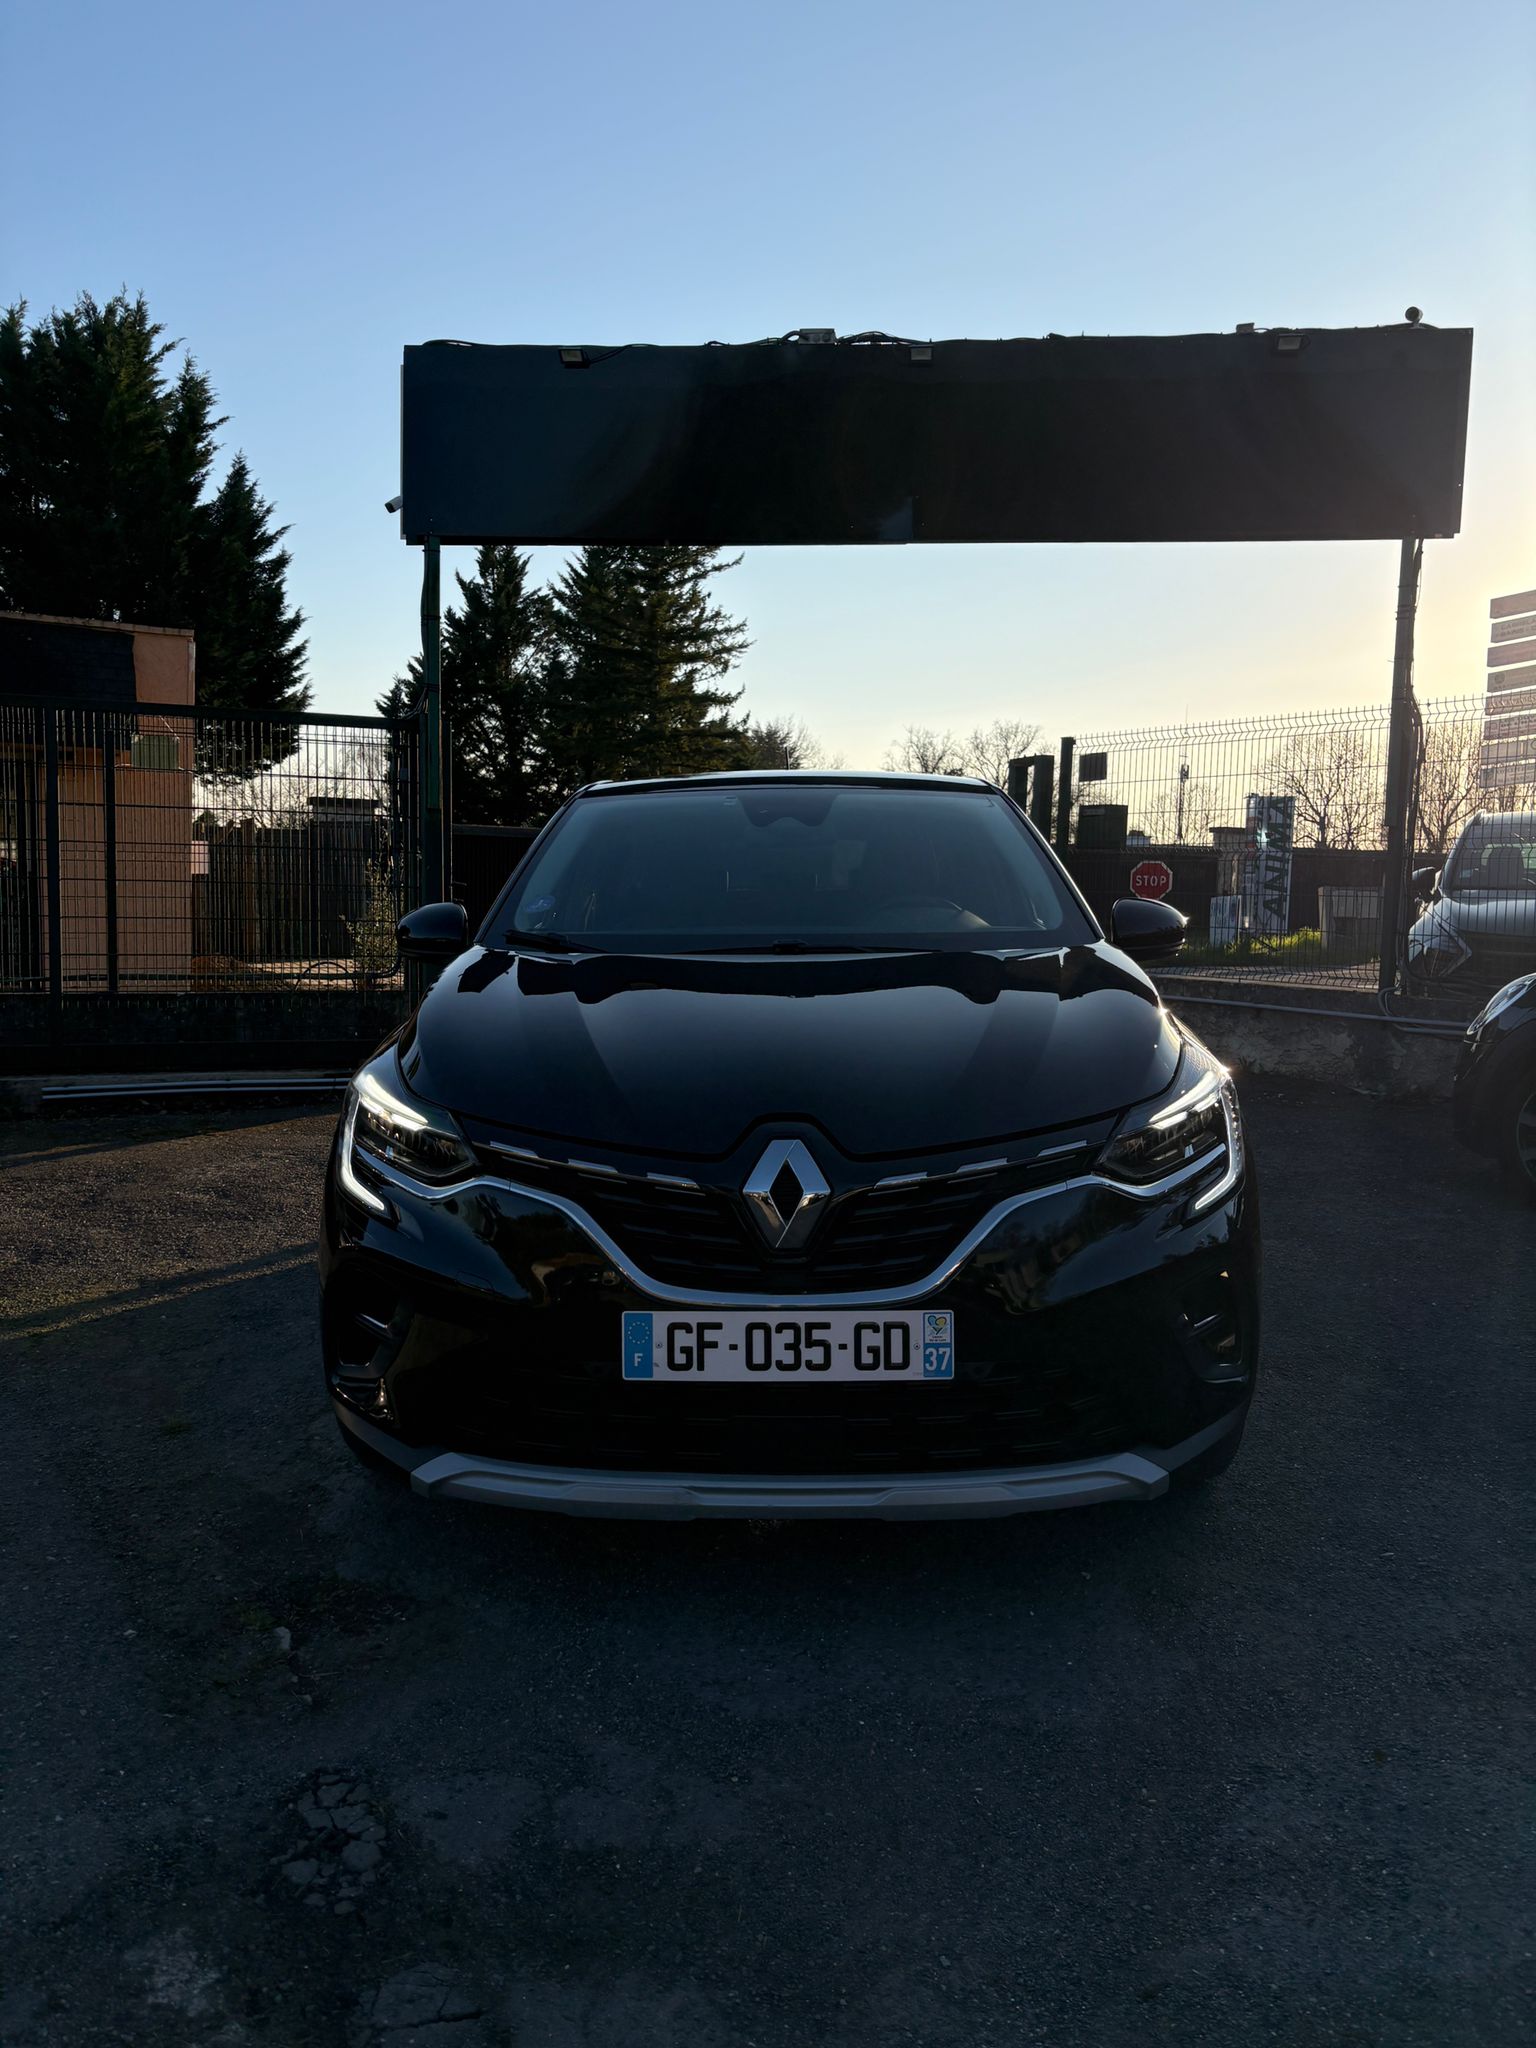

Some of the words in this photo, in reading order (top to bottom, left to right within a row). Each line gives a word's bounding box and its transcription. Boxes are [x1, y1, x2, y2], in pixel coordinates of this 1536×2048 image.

[1136, 875, 1167, 887] STOP
[667, 1321, 910, 1372] GF-035-GD
[633, 1353, 643, 1367] F
[925, 1347, 951, 1371] 37
